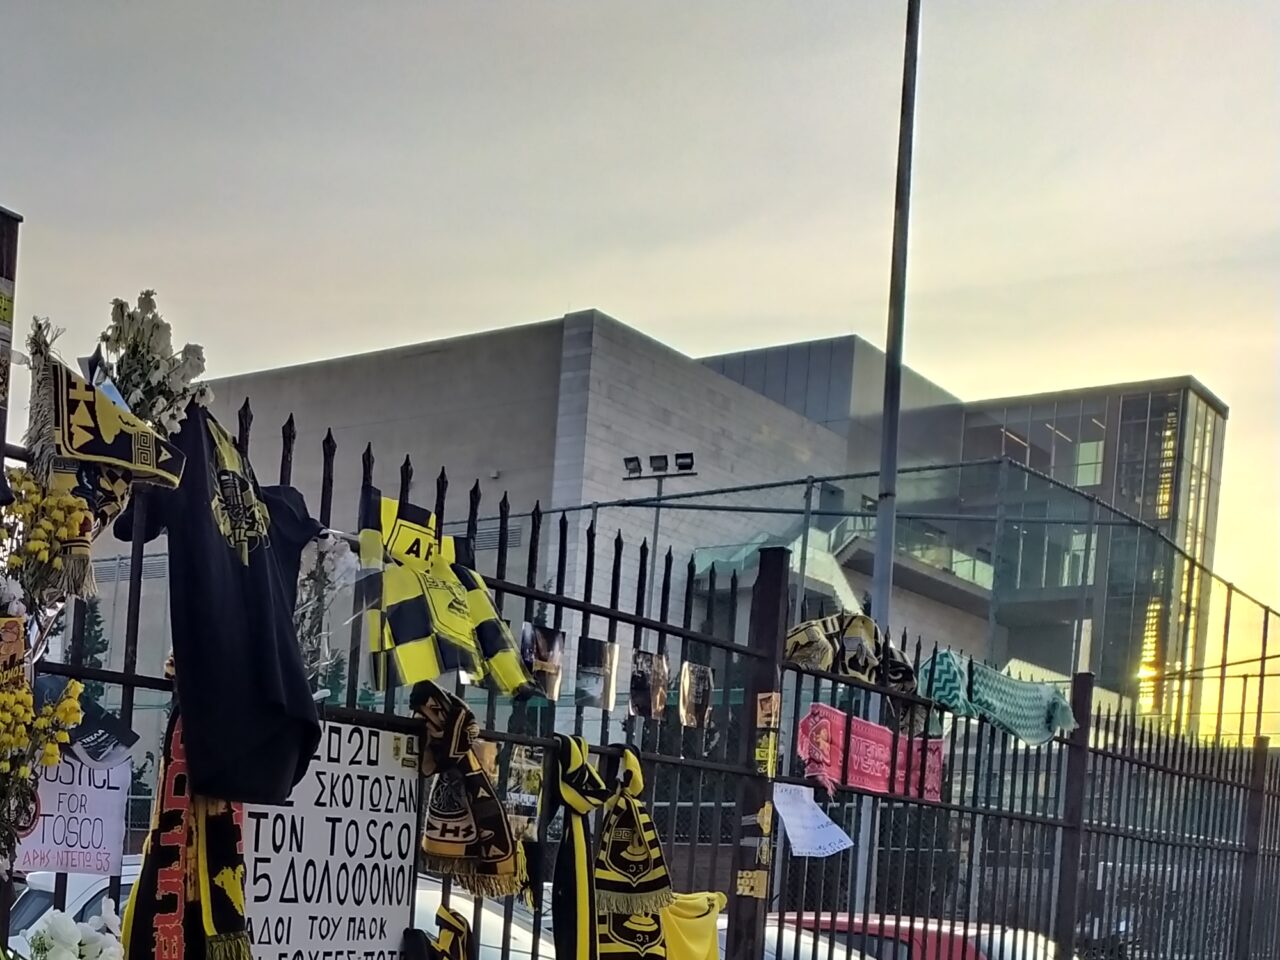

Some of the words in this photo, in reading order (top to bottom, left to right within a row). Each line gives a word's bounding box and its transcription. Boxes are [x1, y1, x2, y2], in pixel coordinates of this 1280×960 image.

[314, 726, 381, 767] 020
[57, 793, 88, 814] FOR
[314, 771, 417, 813] ΣΚΟΤΩΣΑΝ
[253, 857, 271, 903] 5
[278, 856, 413, 907] ΔΟΛΟΦΟΝΟΙ
[346, 916, 387, 942] ΠΑΟΚ
